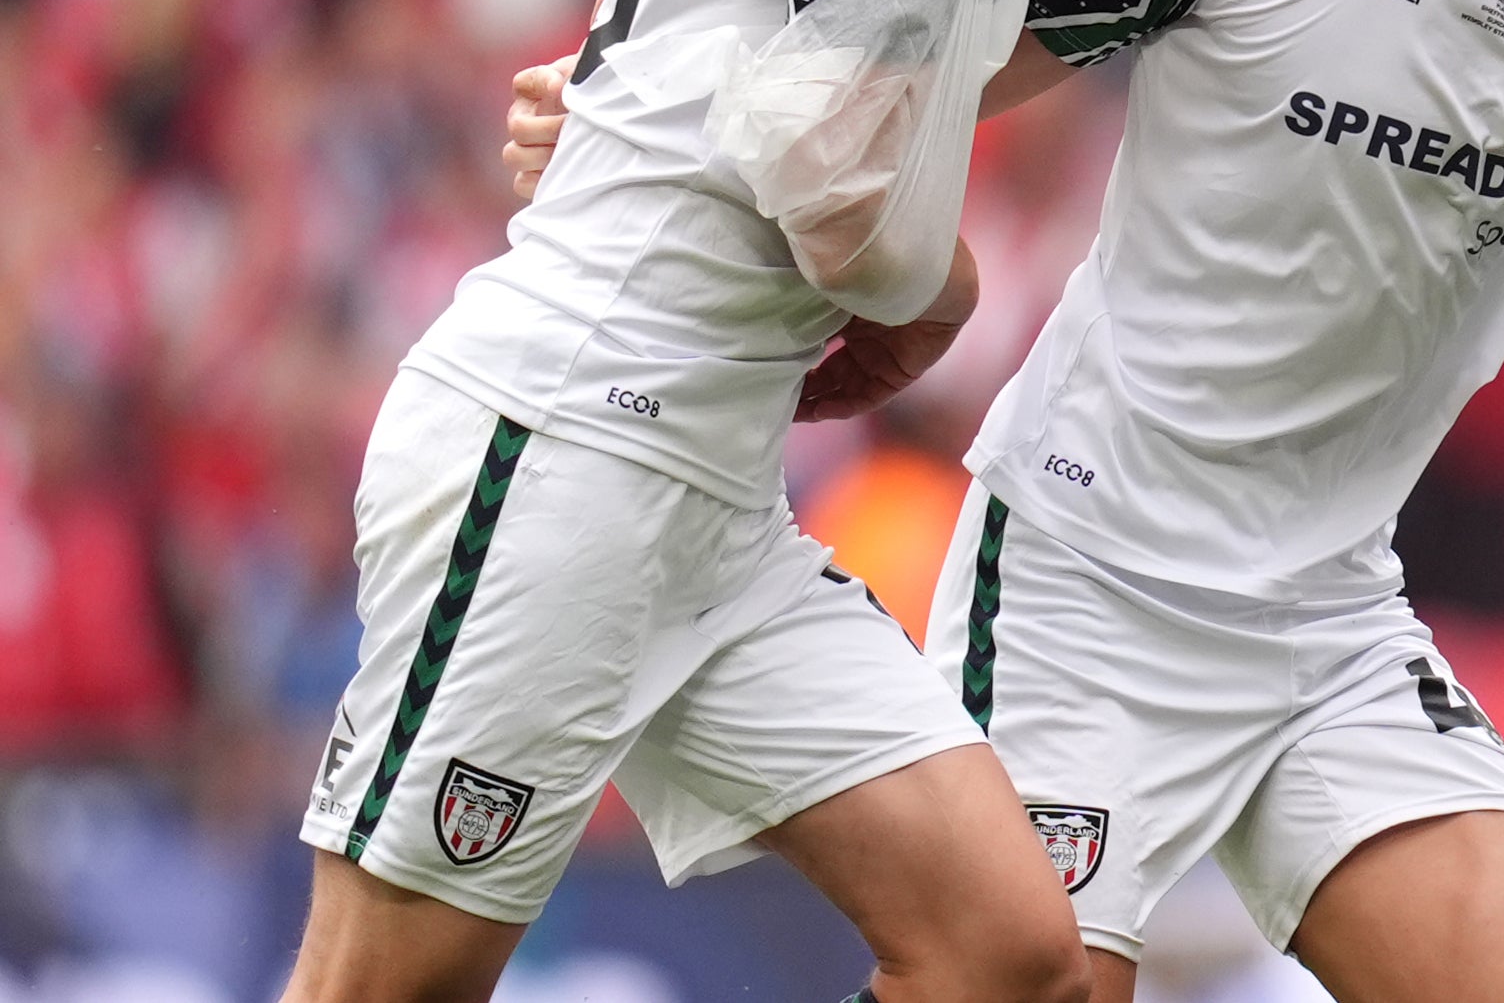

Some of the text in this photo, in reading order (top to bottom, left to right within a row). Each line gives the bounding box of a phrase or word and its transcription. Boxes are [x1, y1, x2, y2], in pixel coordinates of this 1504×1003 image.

[607, 386, 661, 418] ECO8
[1044, 454, 1095, 487] ECO8
[452, 786, 515, 814] SUNDERLAND
[1034, 825, 1097, 838] UNDERLAND
